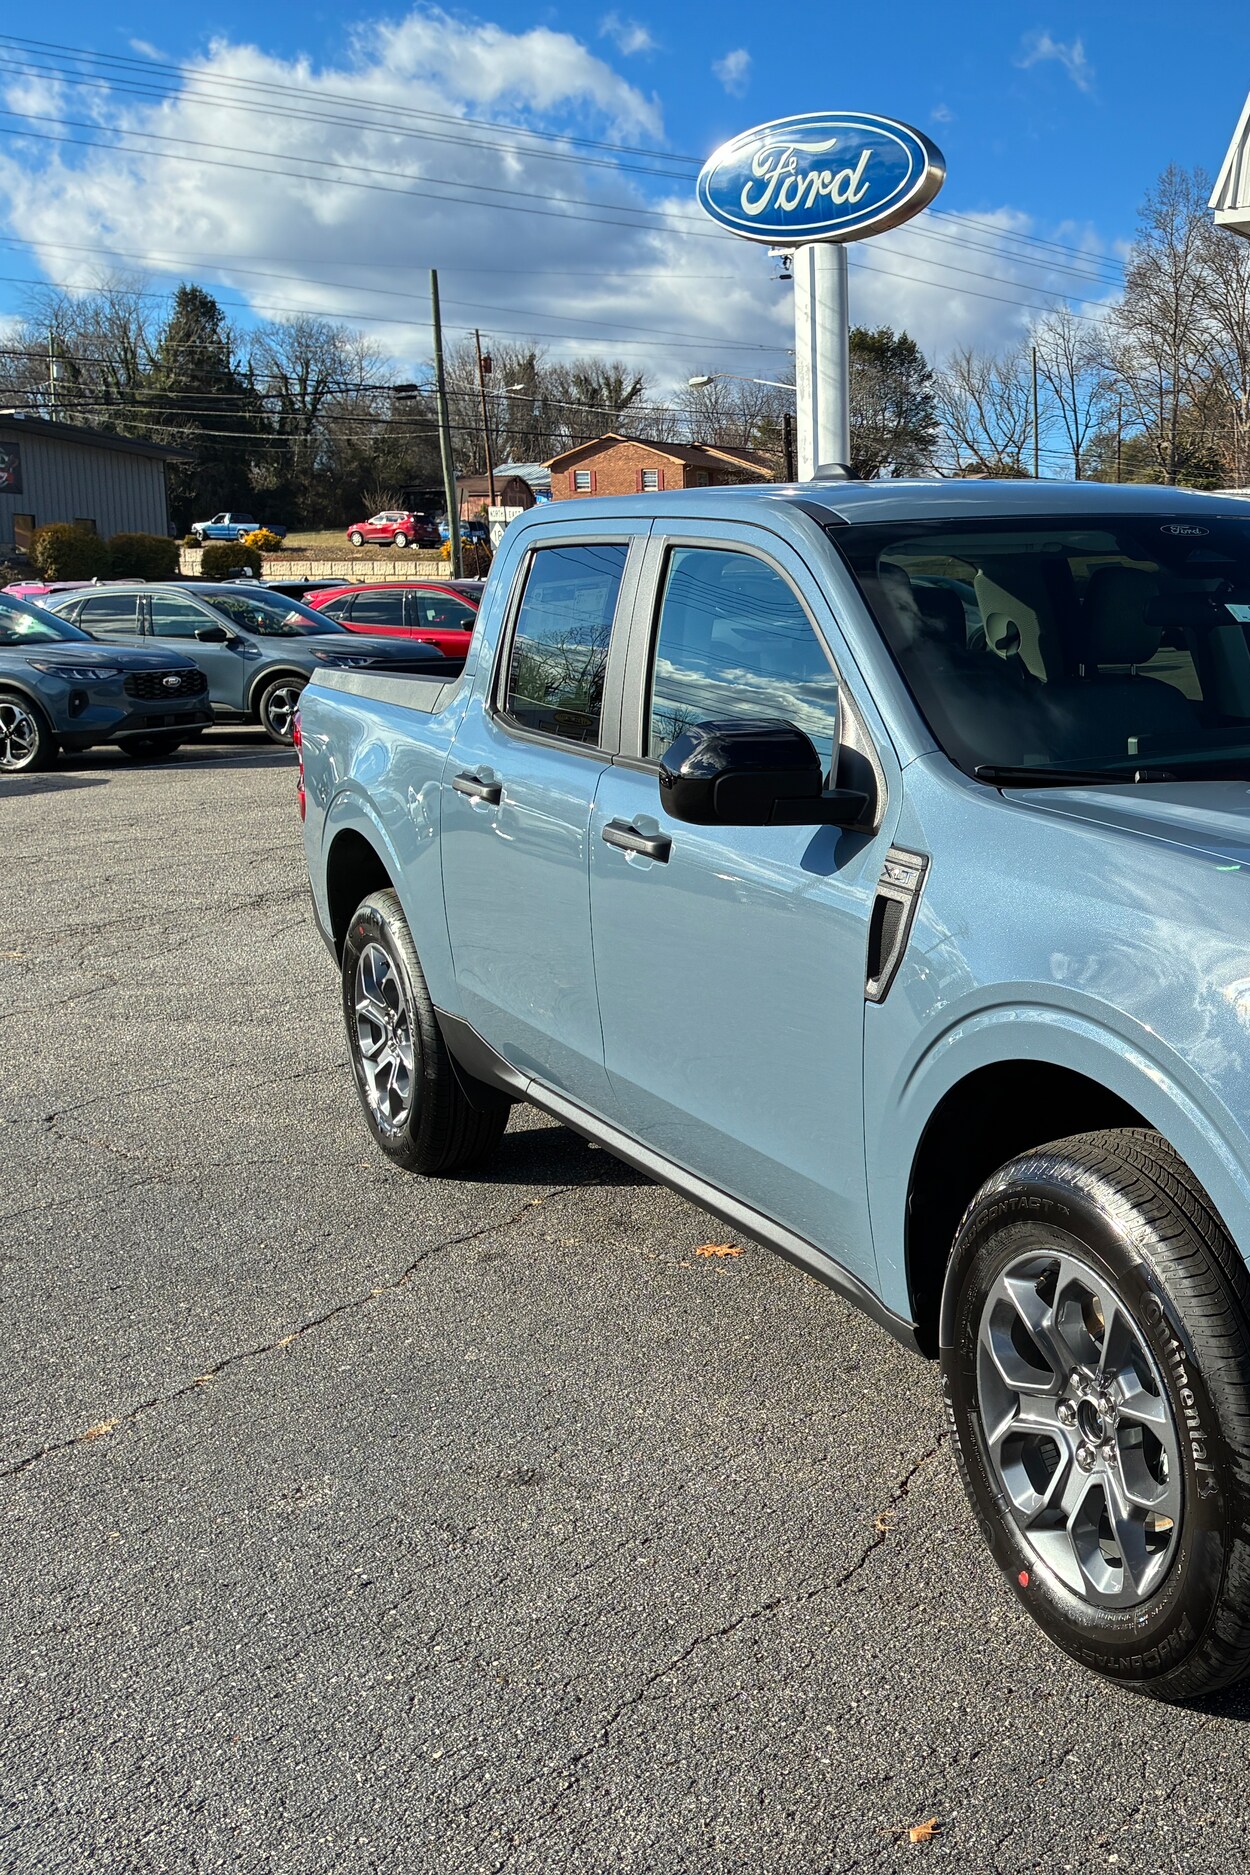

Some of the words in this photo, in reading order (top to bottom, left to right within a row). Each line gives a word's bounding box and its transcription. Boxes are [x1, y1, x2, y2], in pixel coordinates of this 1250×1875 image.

[740, 138, 874, 216] Ford
[1170, 525, 1202, 535] Ford
[881, 864, 916, 885] XLT
[1139, 1289, 1216, 1473] Continental
